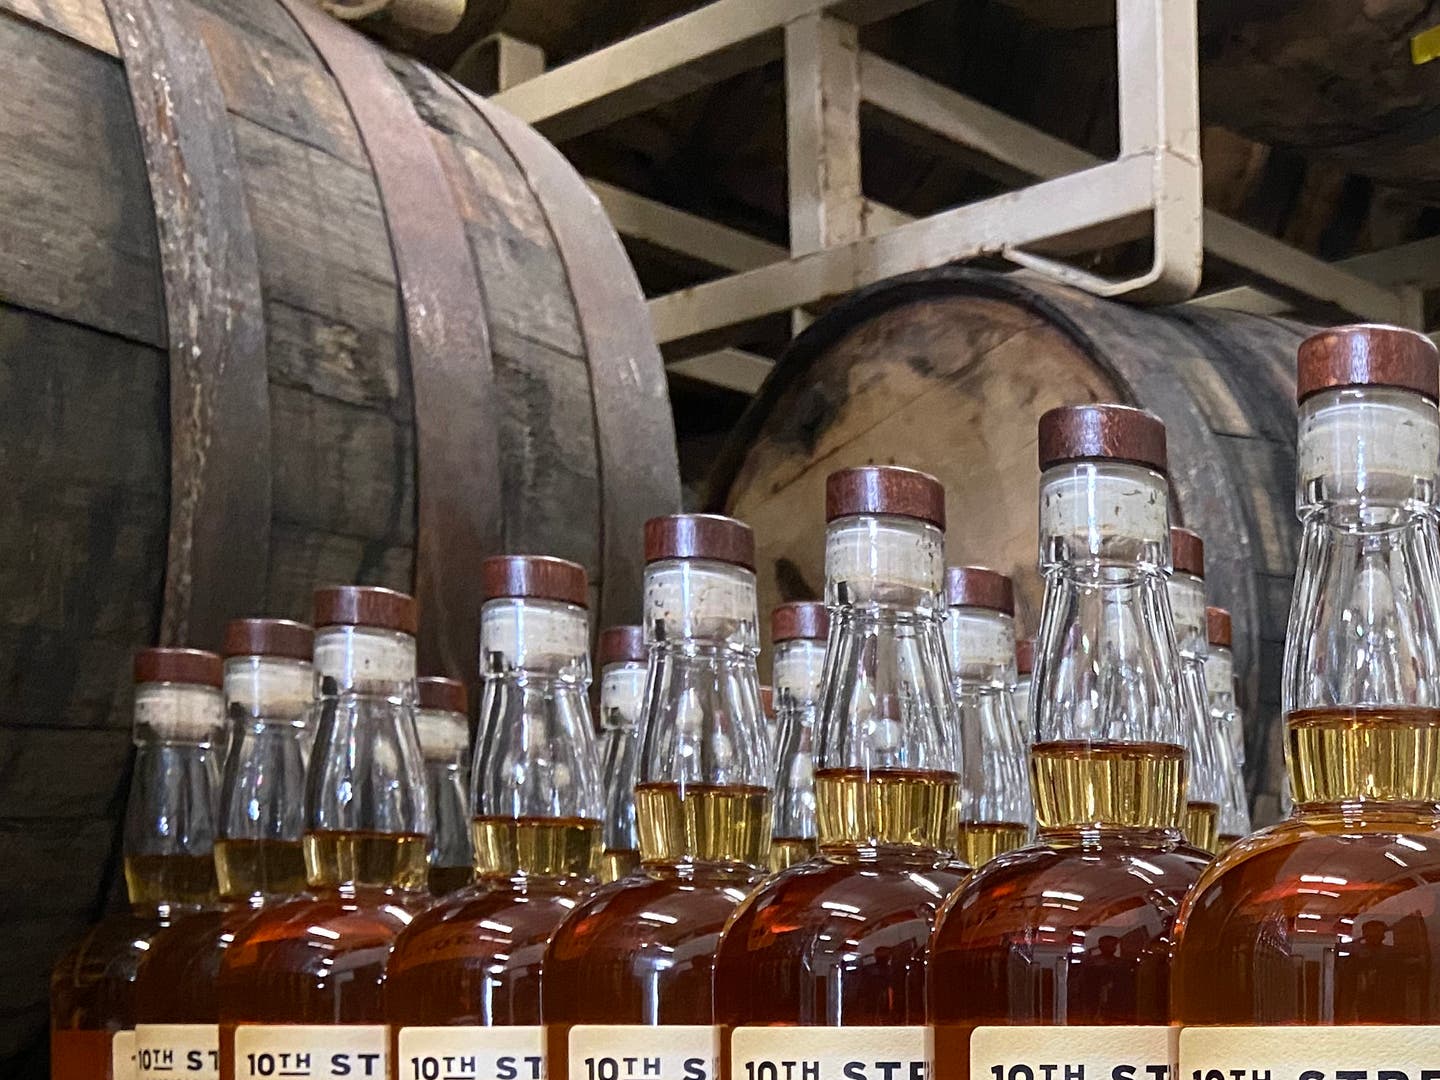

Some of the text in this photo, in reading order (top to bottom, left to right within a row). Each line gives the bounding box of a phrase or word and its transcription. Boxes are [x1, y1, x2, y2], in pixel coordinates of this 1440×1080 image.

[138, 1050, 173, 1071] 10TH
[248, 1053, 310, 1076] 10TH
[411, 1056, 475, 1080] 10TH
